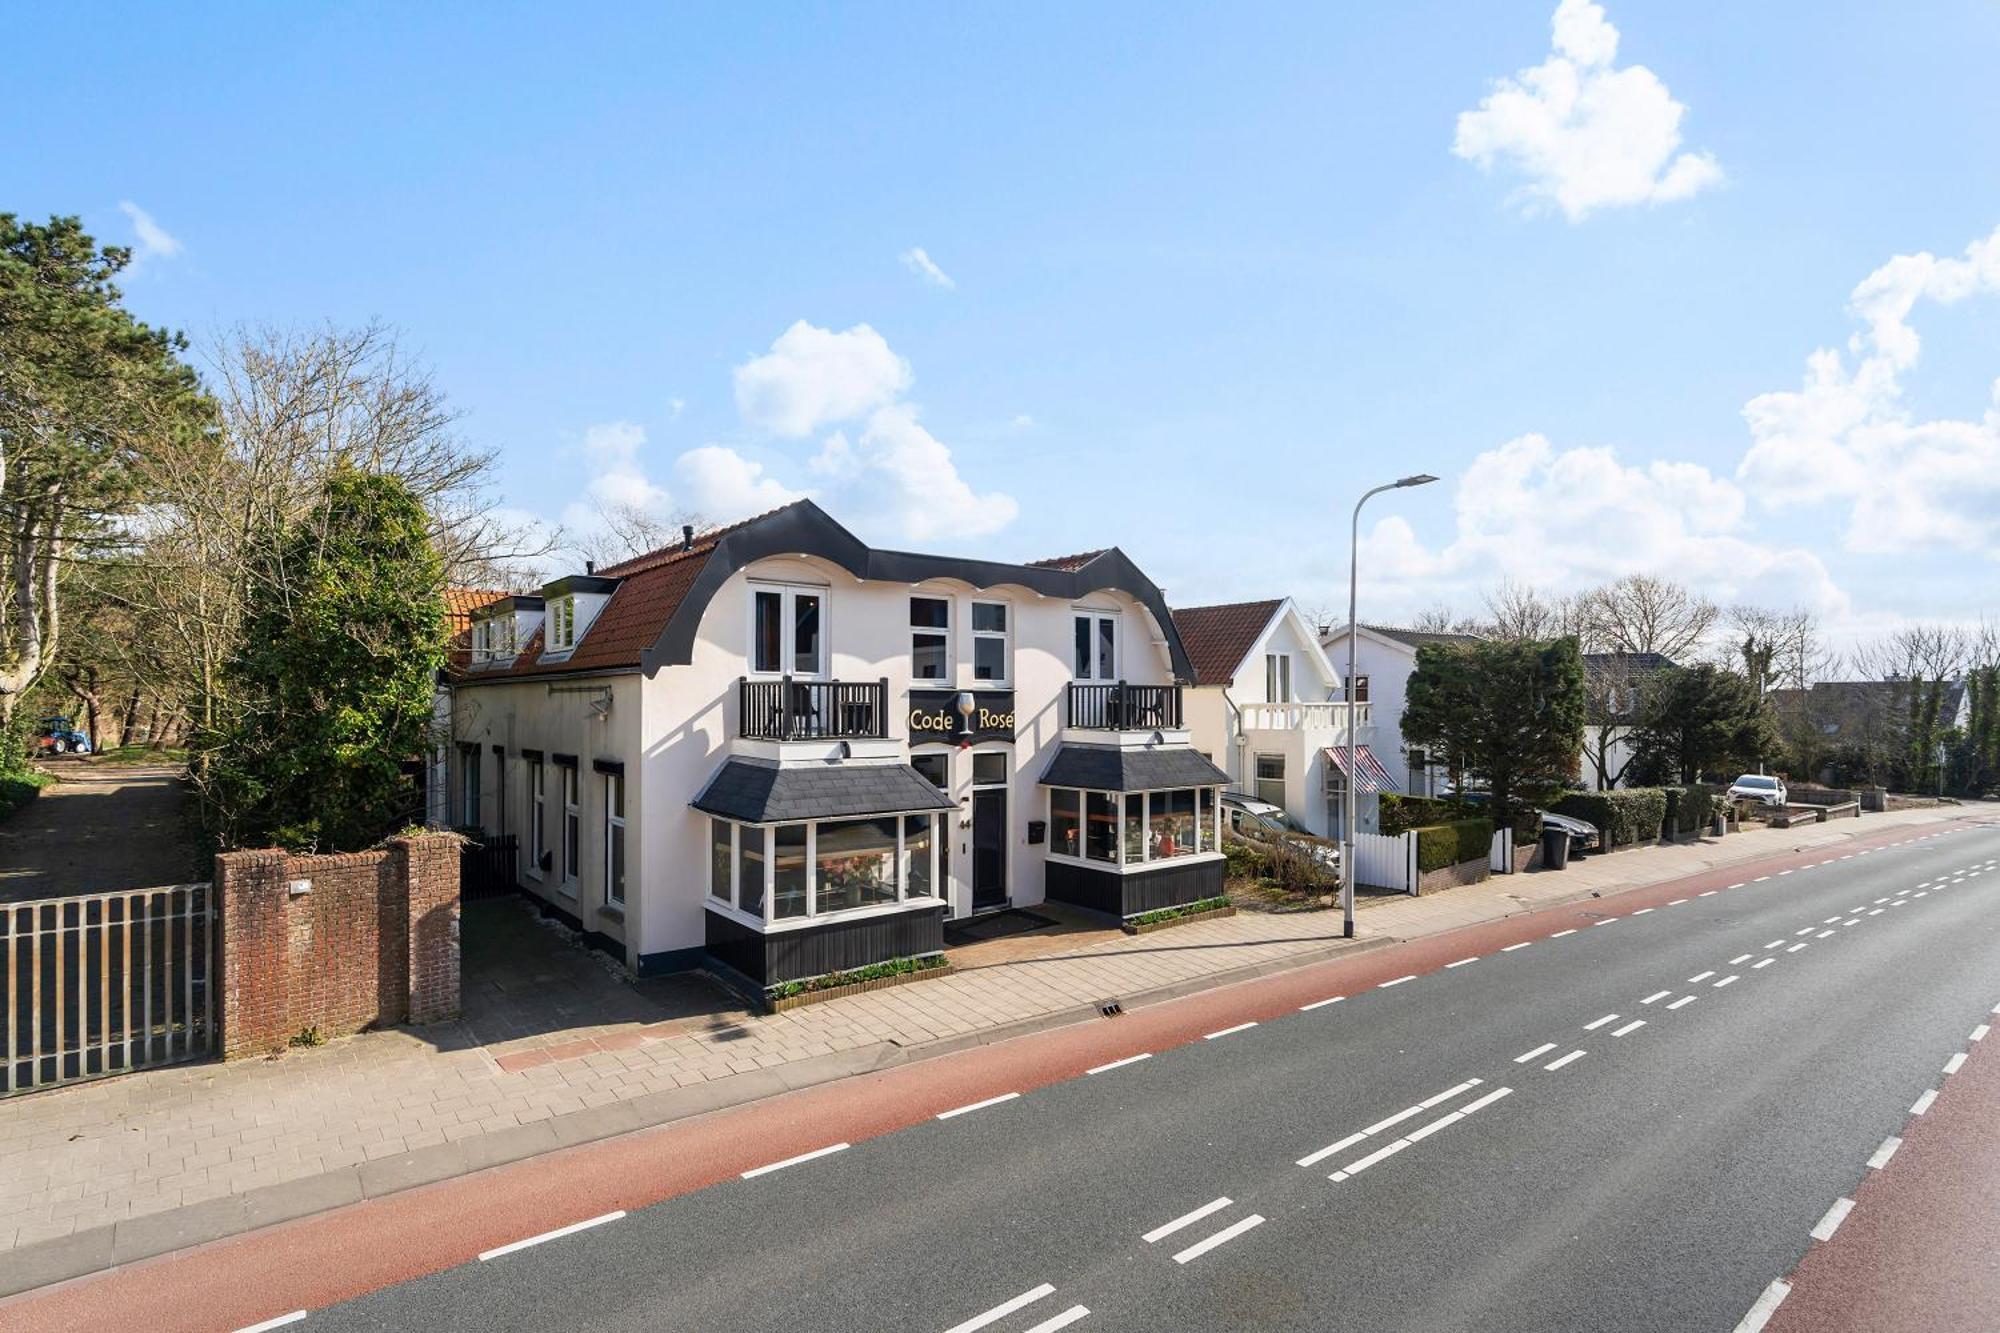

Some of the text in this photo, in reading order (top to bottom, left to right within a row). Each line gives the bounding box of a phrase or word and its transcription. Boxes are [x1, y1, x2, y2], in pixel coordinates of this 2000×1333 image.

[910, 708, 1015, 730] Code Rosé
[959, 820, 971, 830] 44
